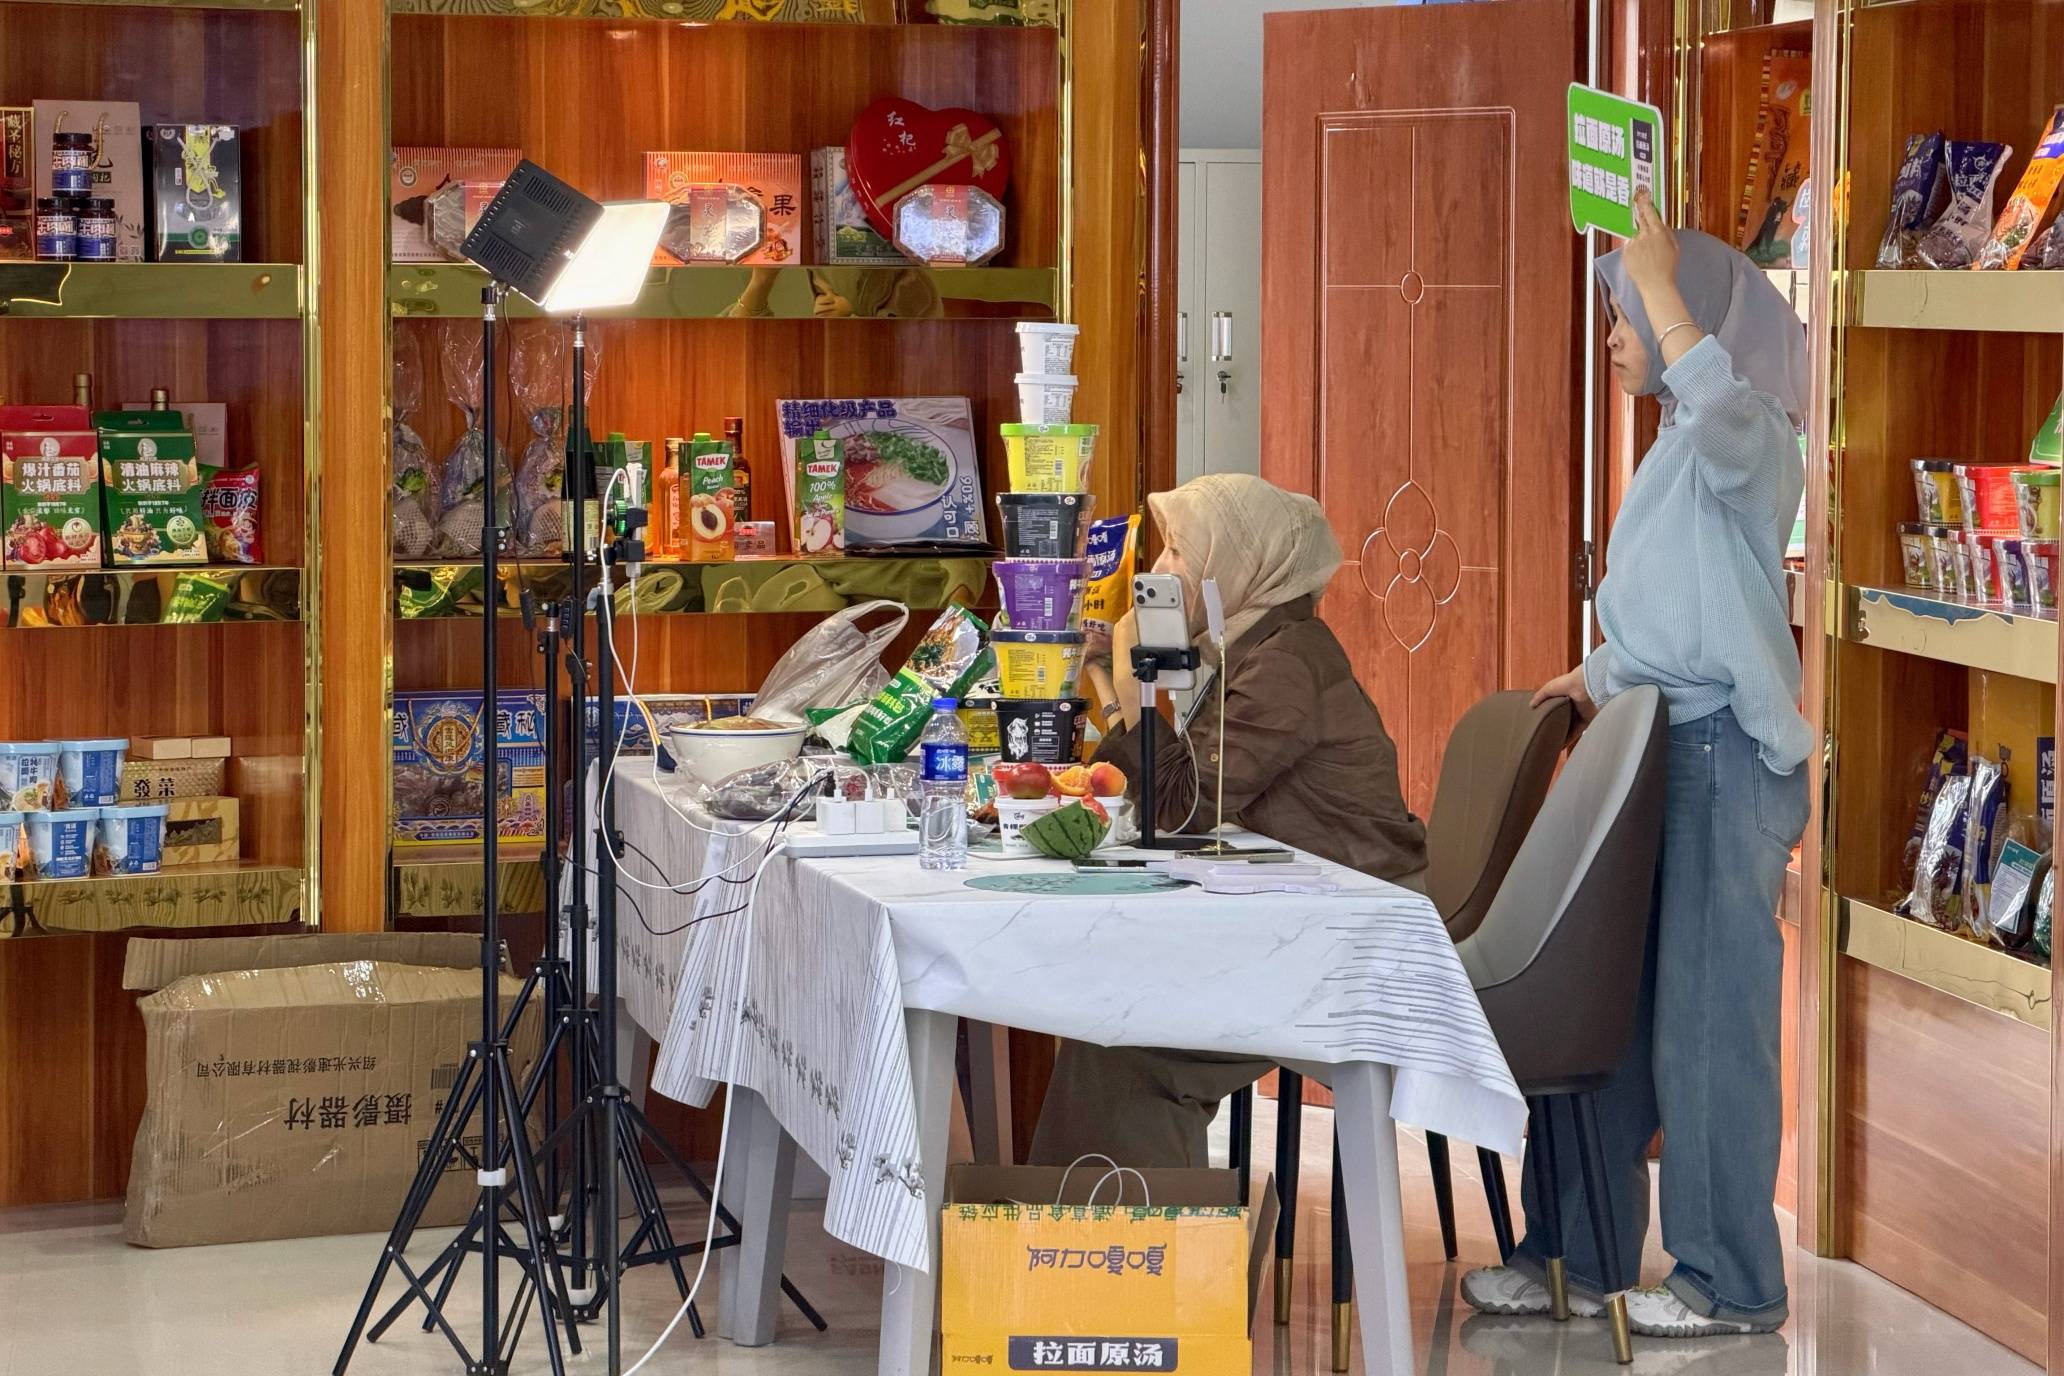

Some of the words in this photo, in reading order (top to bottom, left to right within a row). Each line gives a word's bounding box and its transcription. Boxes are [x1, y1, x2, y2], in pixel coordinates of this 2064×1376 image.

[697, 455, 727, 466] TAMEK
[22, 462, 80, 477] 爆汁番茄
[120, 462, 180, 477] 清油麻辣
[808, 463, 838, 474] TAMEK
[22, 479, 81, 492] 火锅底料
[122, 479, 181, 492] 火锅底料
[702, 474, 724, 486] Peach
[809, 480, 836, 493] 100%
[935, 755, 965, 772] 冰露
[284, 1092, 413, 1130] 摄影器材
[1033, 1341, 1163, 1367] 拉面原汤
